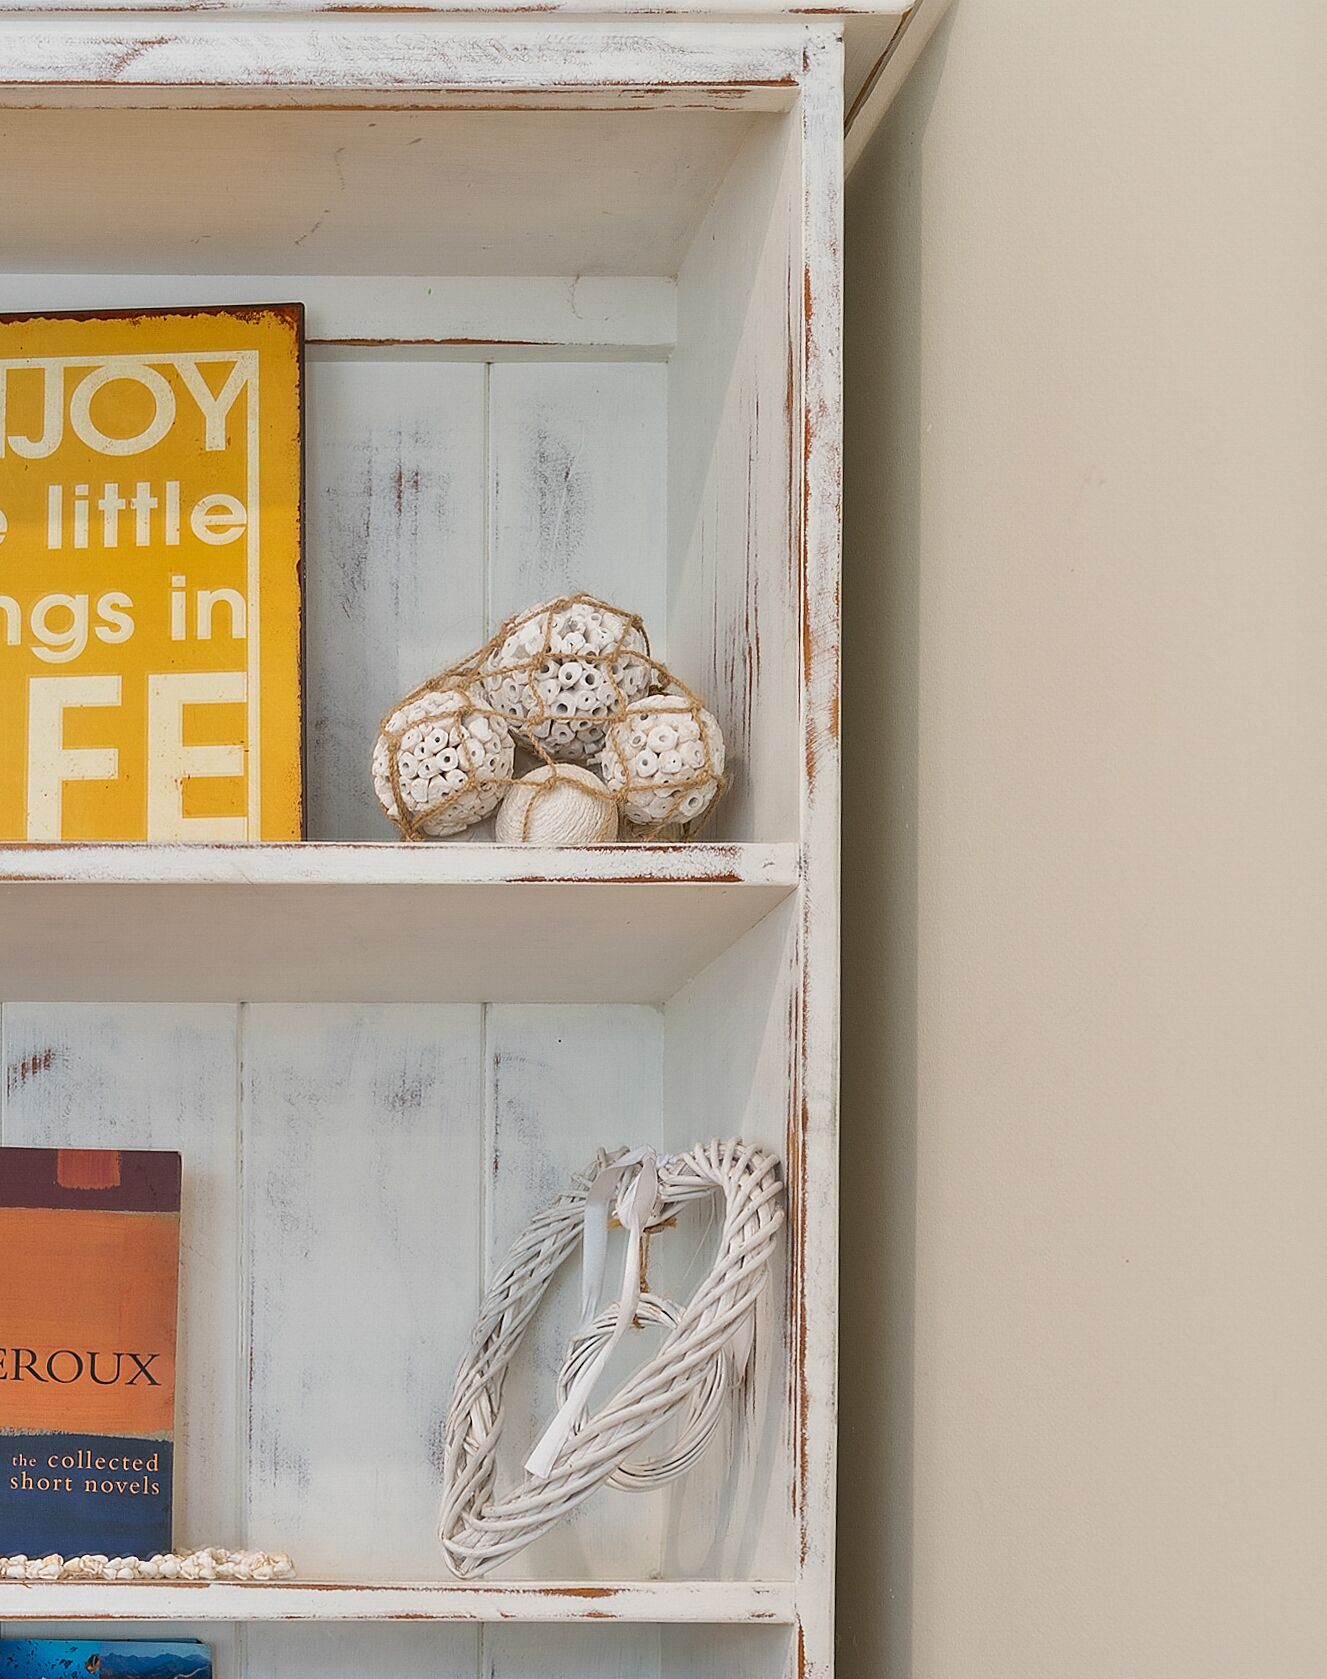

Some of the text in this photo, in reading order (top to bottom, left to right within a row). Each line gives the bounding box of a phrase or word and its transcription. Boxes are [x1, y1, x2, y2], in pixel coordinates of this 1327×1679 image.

[47, 481, 248, 550] little
[171, 574, 247, 642] in
[9, 1471, 161, 1495] short novels
[12, 1450, 160, 1472] the collected
